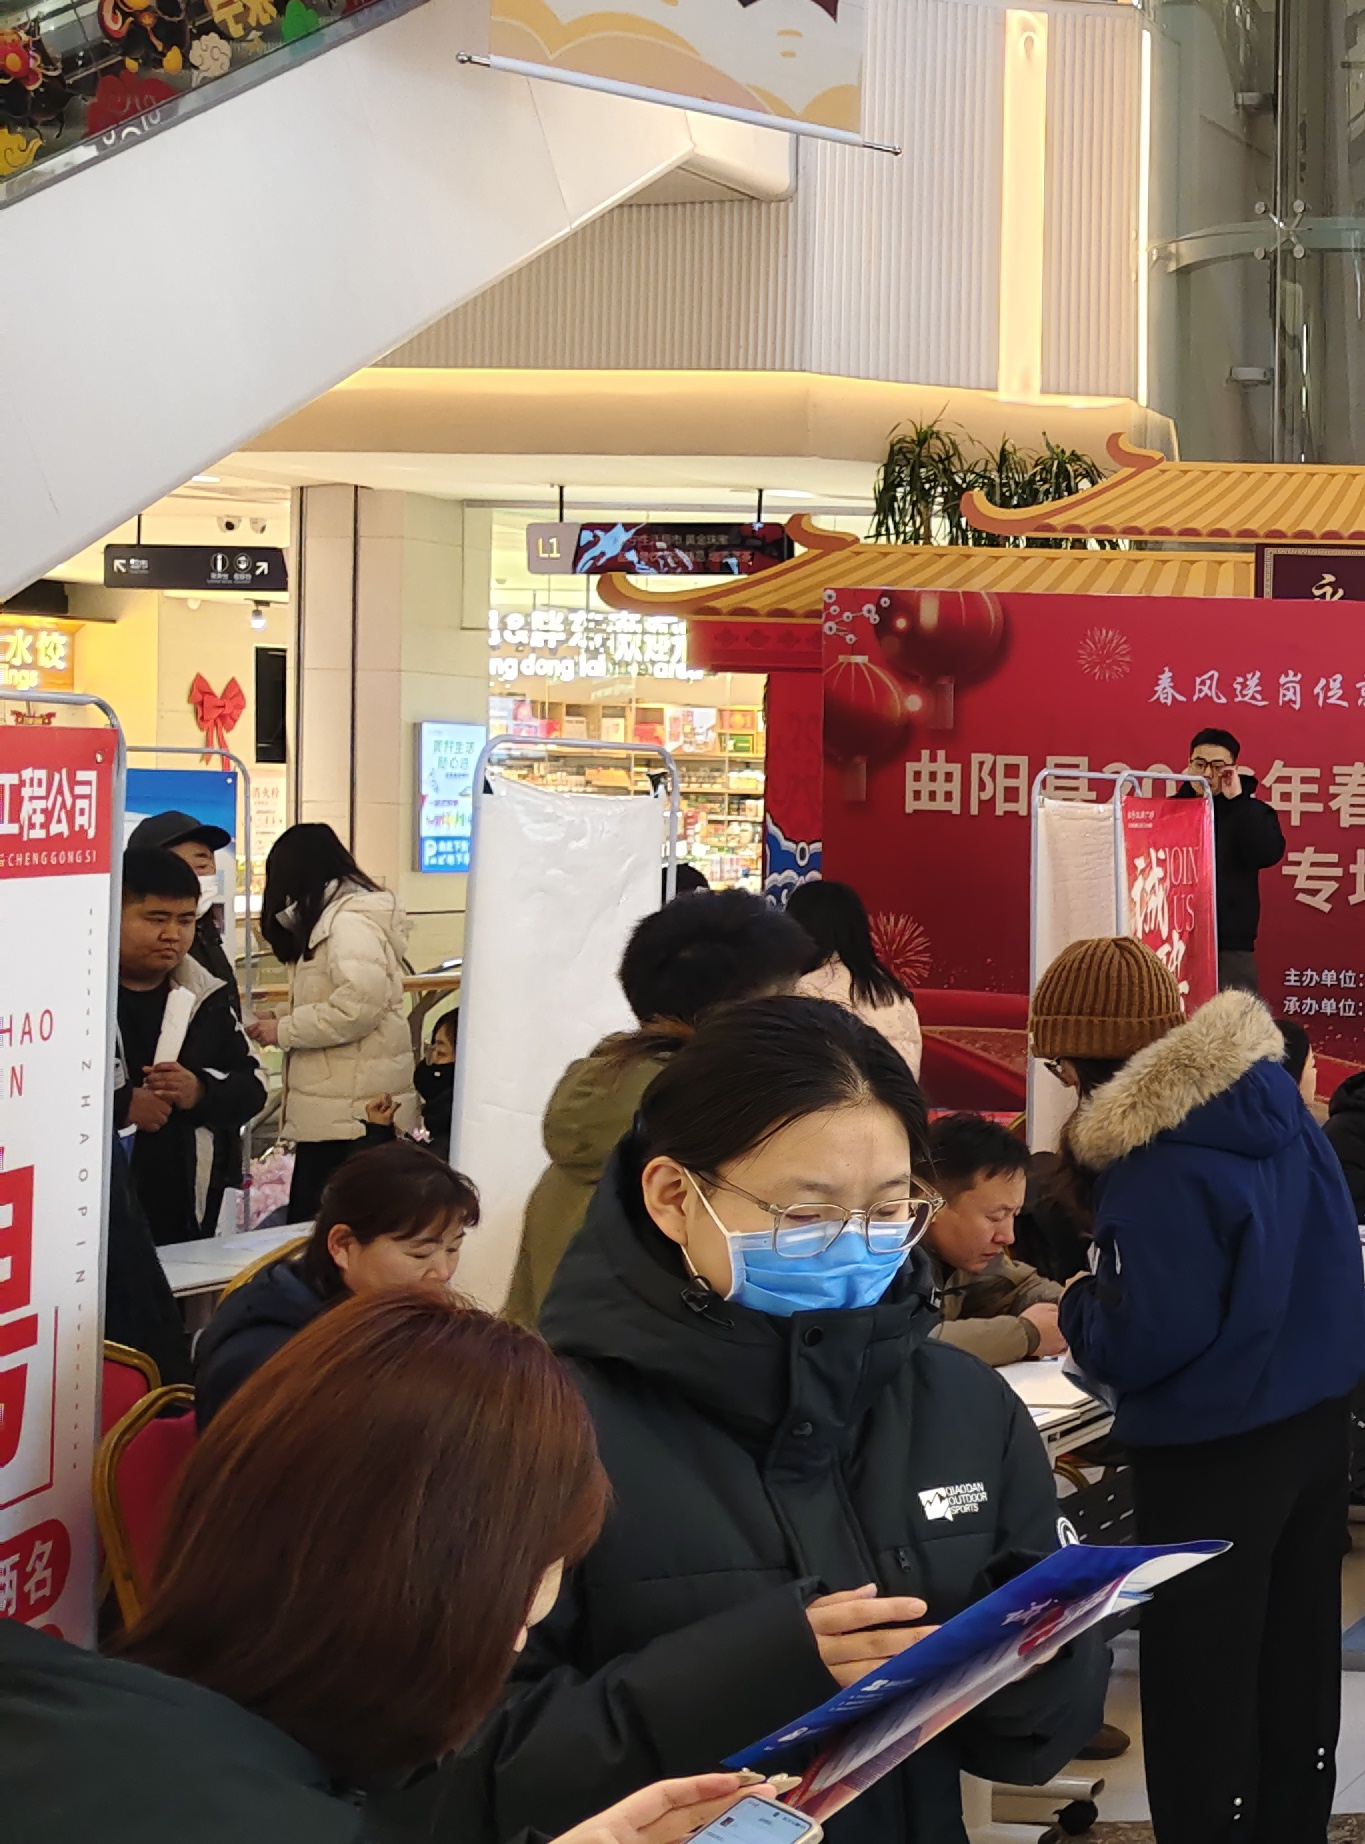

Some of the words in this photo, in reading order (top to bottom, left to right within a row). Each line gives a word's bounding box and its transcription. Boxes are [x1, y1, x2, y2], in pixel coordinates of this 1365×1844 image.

[537, 537, 560, 558] L1
[1165, 846, 1200, 891] JOIN
[1172, 893, 1196, 933] US
[945, 1481, 984, 1496] QIAODAN
[948, 1492, 988, 1506] OUTDOOR
[950, 1503, 979, 1515] SPORTS
